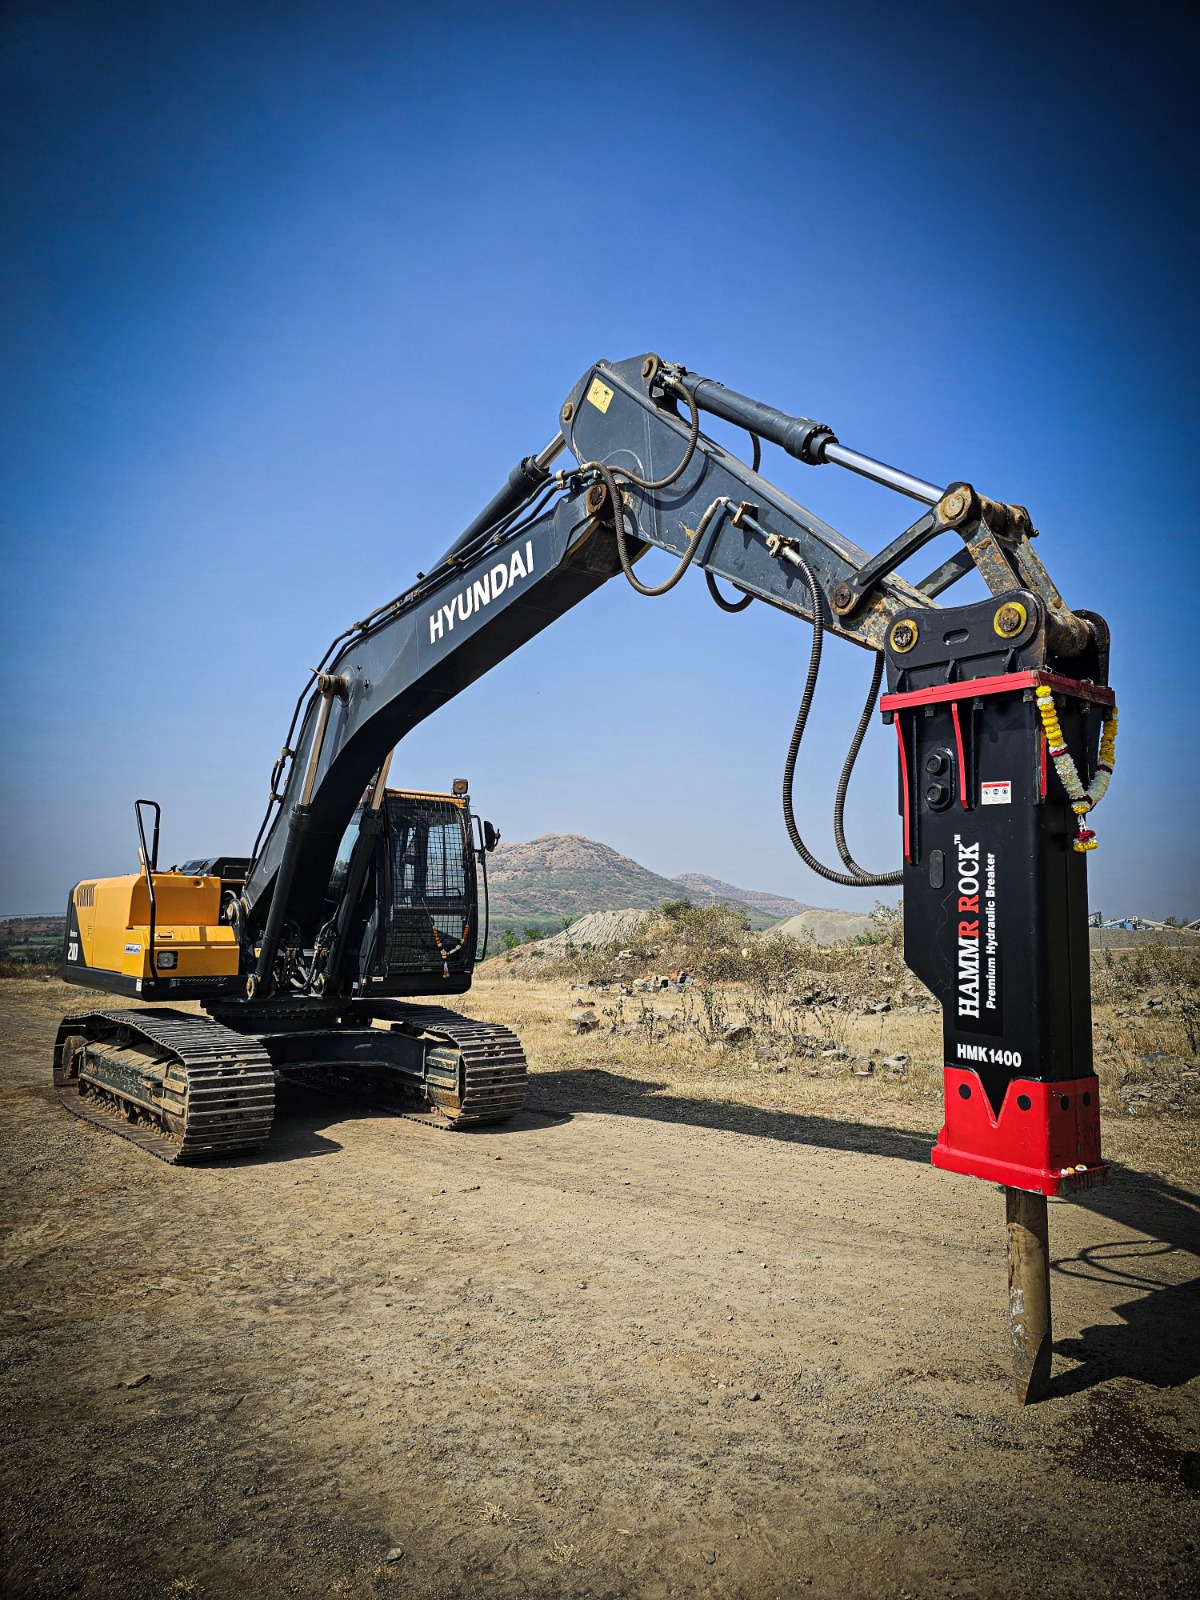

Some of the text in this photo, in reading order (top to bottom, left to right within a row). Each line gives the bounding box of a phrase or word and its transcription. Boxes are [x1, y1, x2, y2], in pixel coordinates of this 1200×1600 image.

[430, 540, 534, 645] HYUNDAI
[958, 842, 979, 913] ROCK
[958, 920, 979, 1018] HAMMR
[985, 853, 998, 1009] Premium Hydraulic Breaker
[957, 1043, 1022, 1068] HMK 1400
